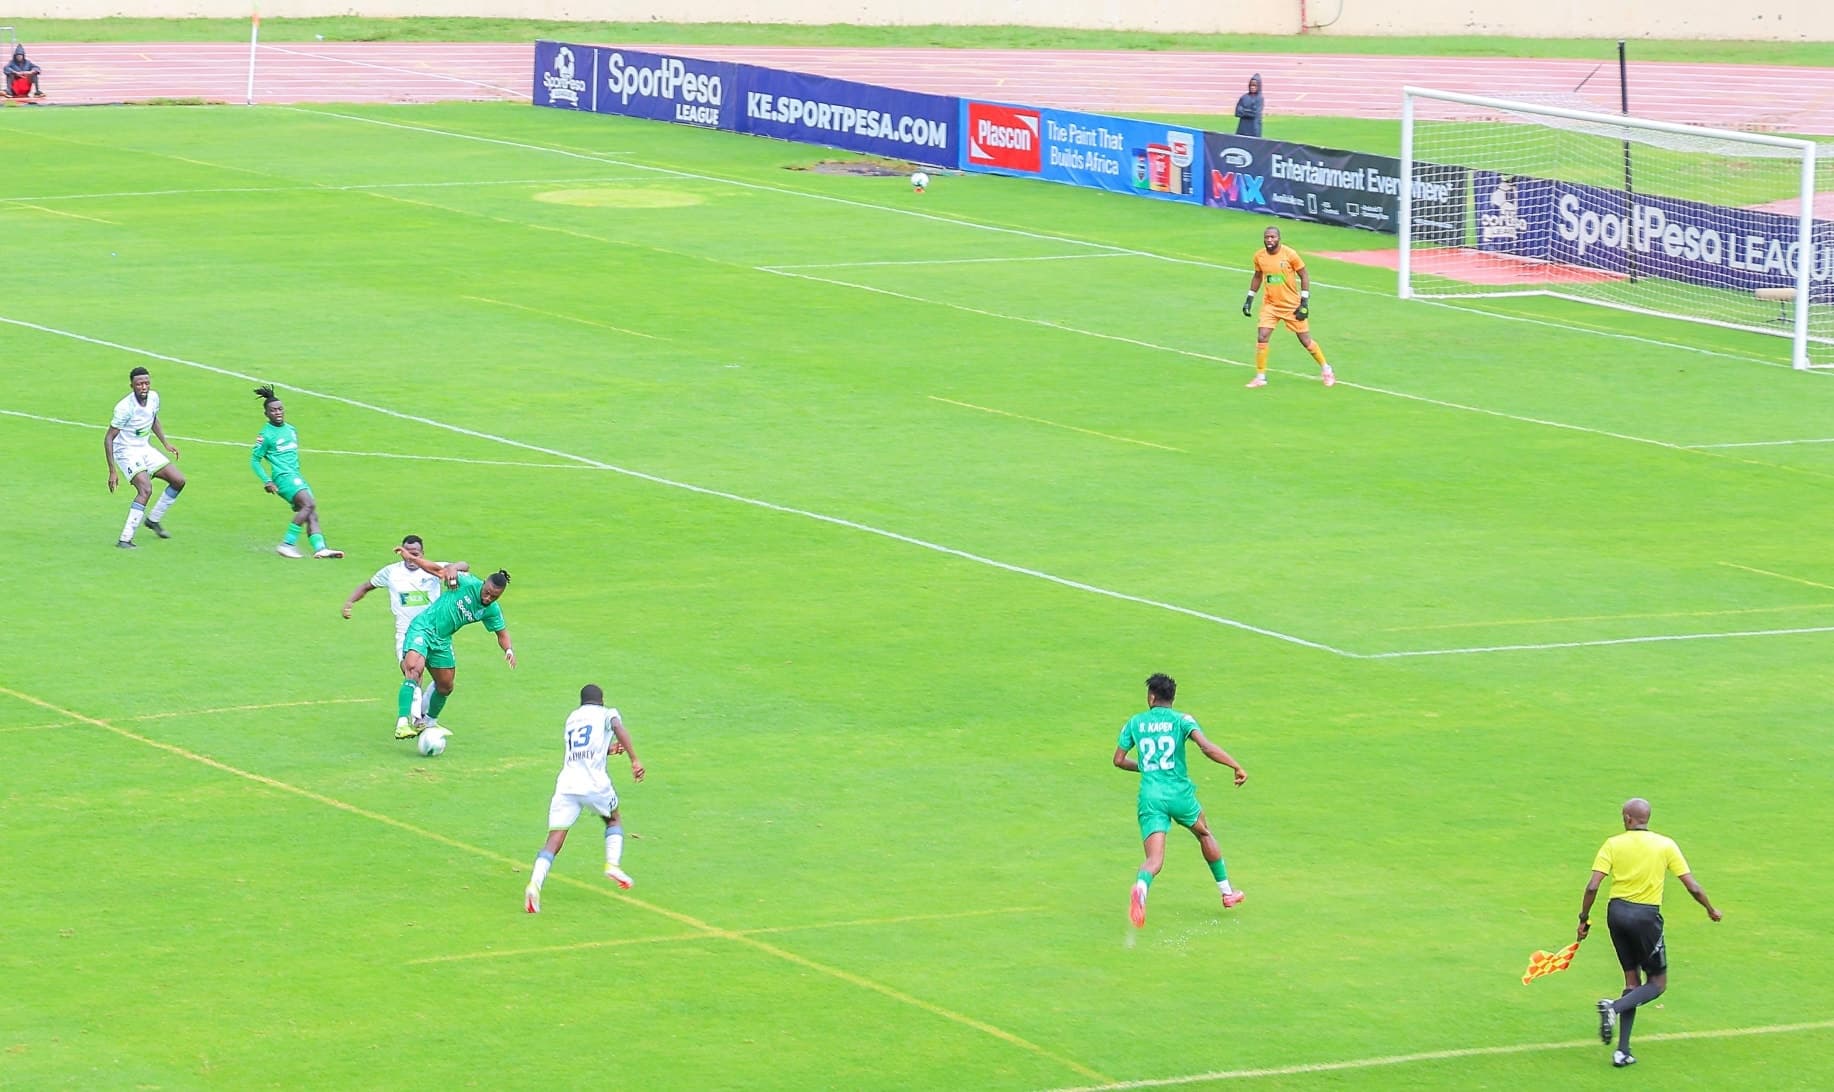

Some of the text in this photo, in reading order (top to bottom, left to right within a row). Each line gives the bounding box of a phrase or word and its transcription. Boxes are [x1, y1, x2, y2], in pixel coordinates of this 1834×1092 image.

[608, 53, 722, 105] SportPesa
[676, 103, 720, 125] LEAGUE
[747, 91, 947, 148] KE.SPORTPESA.COM
[978, 119, 1031, 150] Plascon
[1047, 120, 1124, 151] The Paint That
[1050, 145, 1119, 175] Builds Africa
[1271, 153, 1365, 191] Entertainment
[1211, 169, 1266, 205] MIX
[1559, 193, 1722, 264] SportPesa
[568, 724, 593, 752] 13
[1139, 735, 1176, 773] 22
